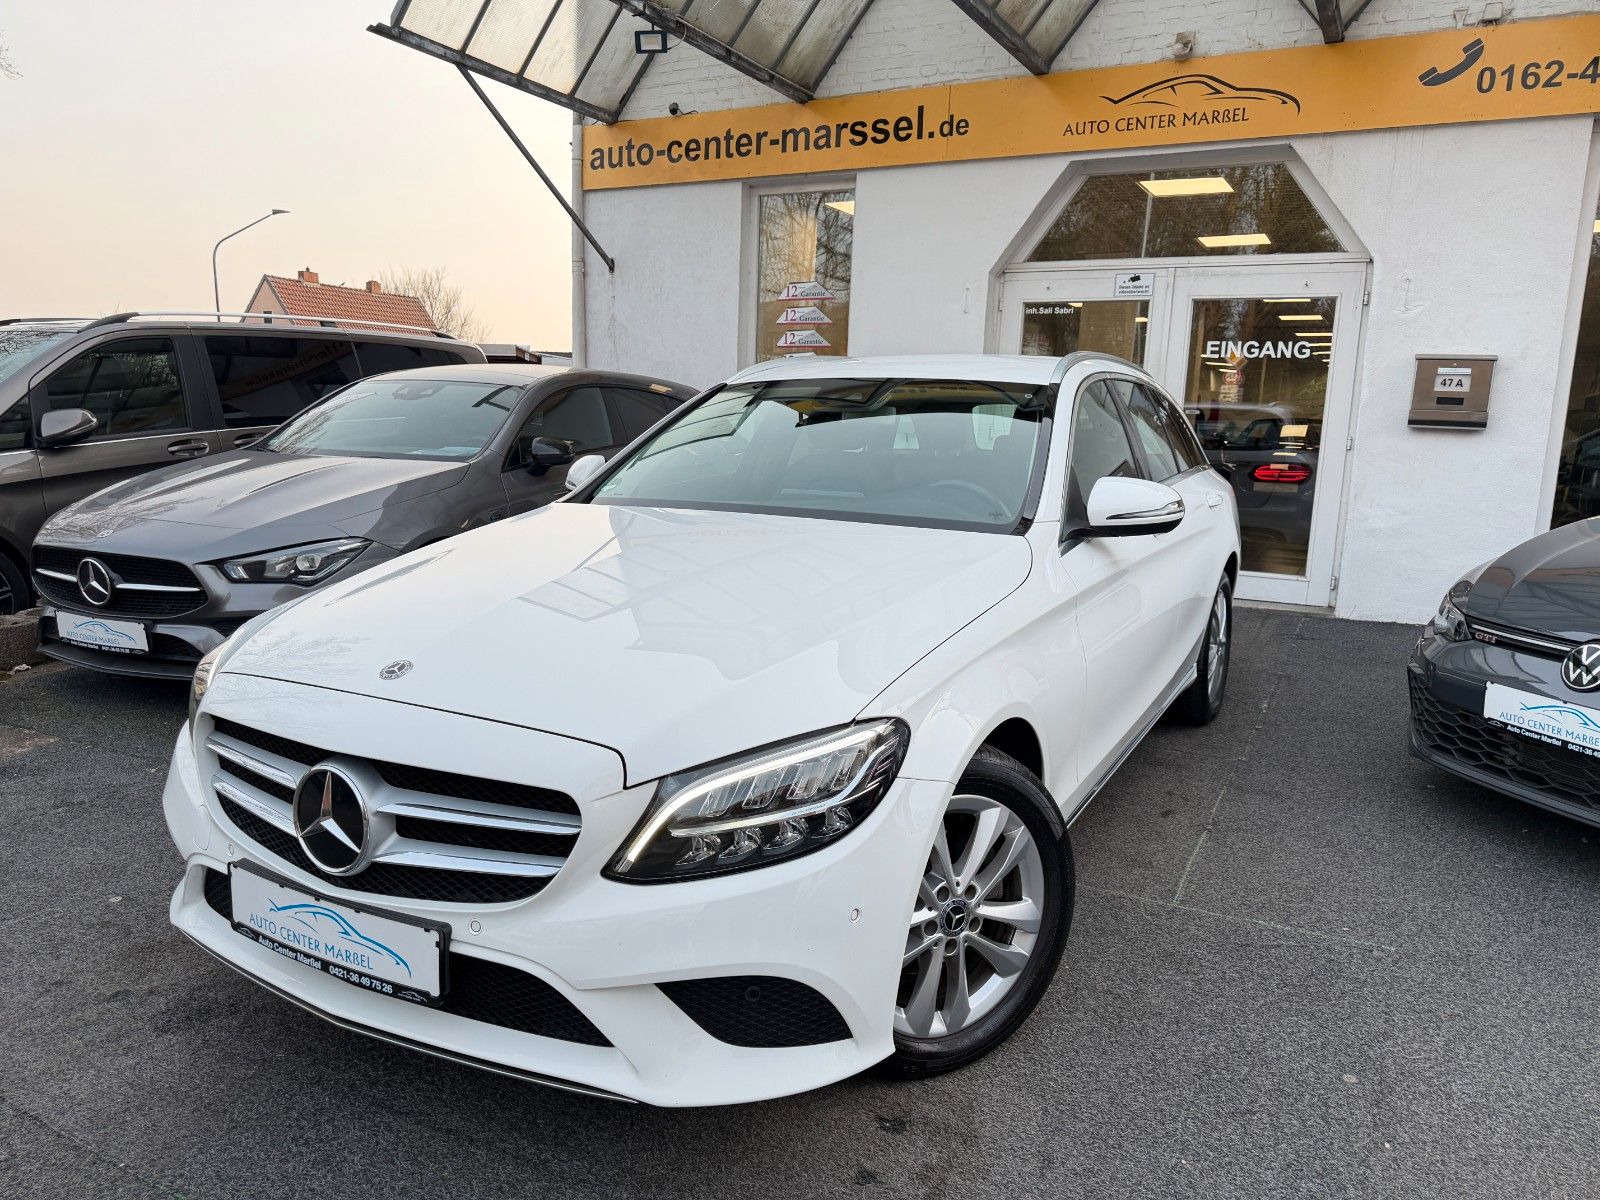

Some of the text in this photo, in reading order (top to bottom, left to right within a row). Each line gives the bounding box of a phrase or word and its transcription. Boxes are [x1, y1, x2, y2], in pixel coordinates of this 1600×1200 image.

[1477, 56, 1600, 93] 0162-4
[1063, 120, 1110, 136] AUTO
[1115, 114, 1176, 132] CENTER
[590, 104, 970, 170] auto-center-marssel.de
[785, 285, 798, 297] 12
[784, 310, 796, 322] 12
[783, 333, 796, 345] 12
[1206, 341, 1311, 359] EINGANG
[1440, 378, 1463, 387] 47 A
[1475, 632, 1499, 644] GTI
[1500, 712, 1524, 724] AUTO
[1528, 720, 1562, 736] CENTER
[1507, 725, 1520, 734] Auto
[249, 914, 277, 934] AUTO
[280, 926, 321, 953] CENTER
[258, 935, 273, 950] Auto
[273, 942, 296, 960] Center
[329, 965, 360, 983] 0421-36
[360, 976, 370, 987] 49
[371, 979, 382, 990] 75
[382, 982, 393, 994] 26
